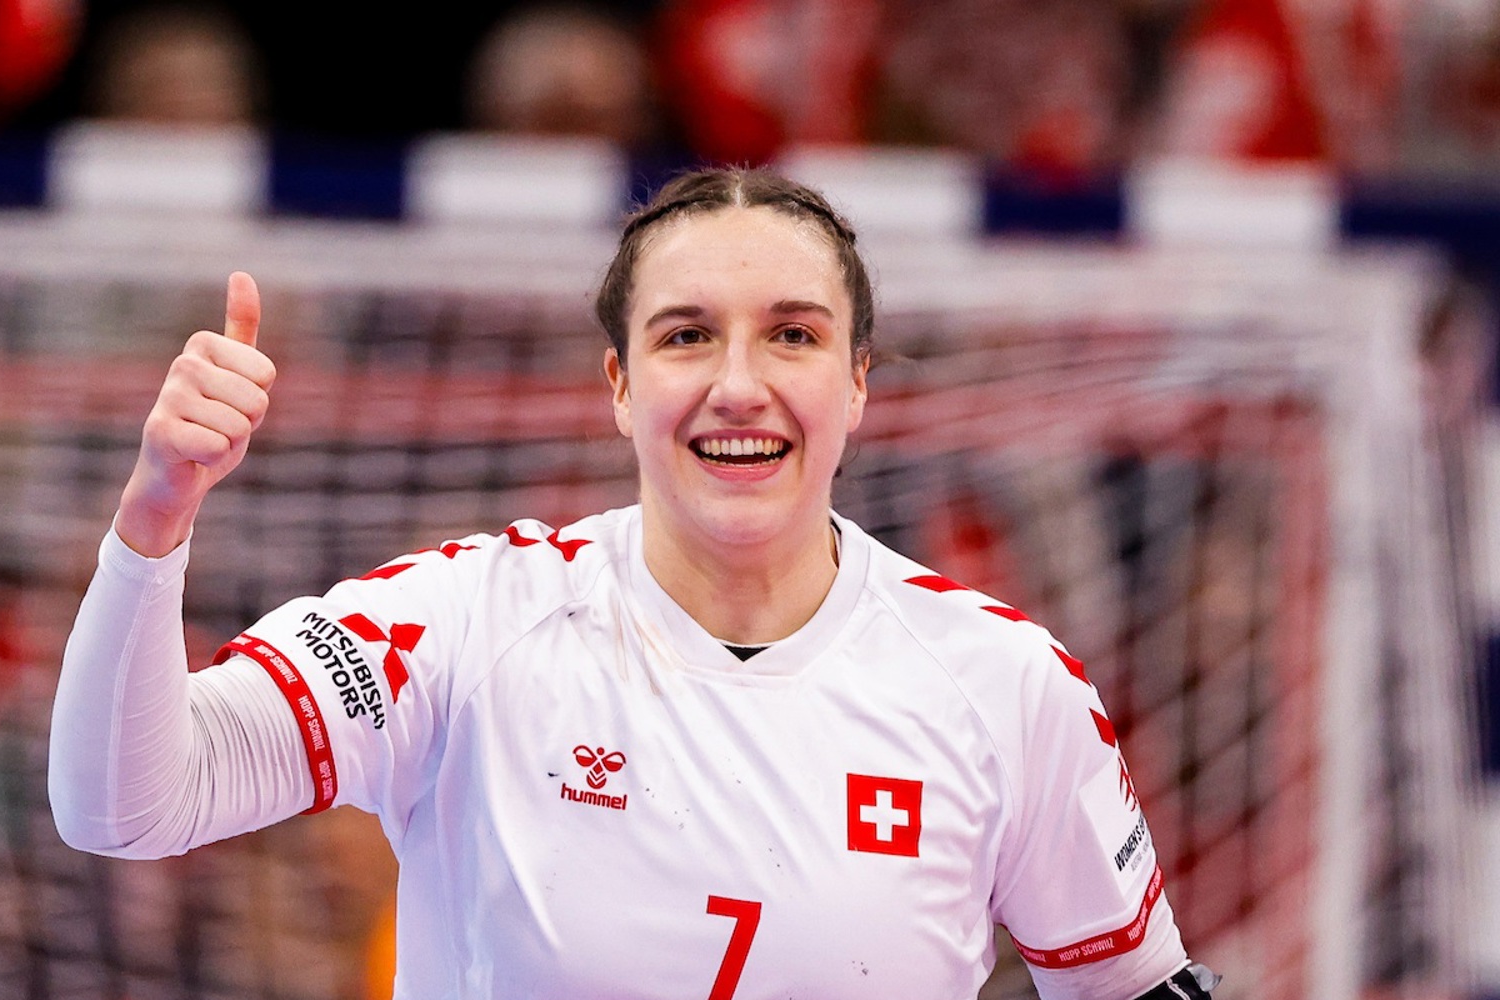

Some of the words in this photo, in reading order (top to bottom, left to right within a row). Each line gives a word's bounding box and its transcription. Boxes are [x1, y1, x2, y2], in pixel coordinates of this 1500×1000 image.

[295, 629, 366, 719] MOTORS
[302, 612, 385, 729] MITSUBISHI
[298, 695, 315, 718] HOPP
[561, 782, 627, 810] hummel
[1059, 949, 1080, 963] HOPP
